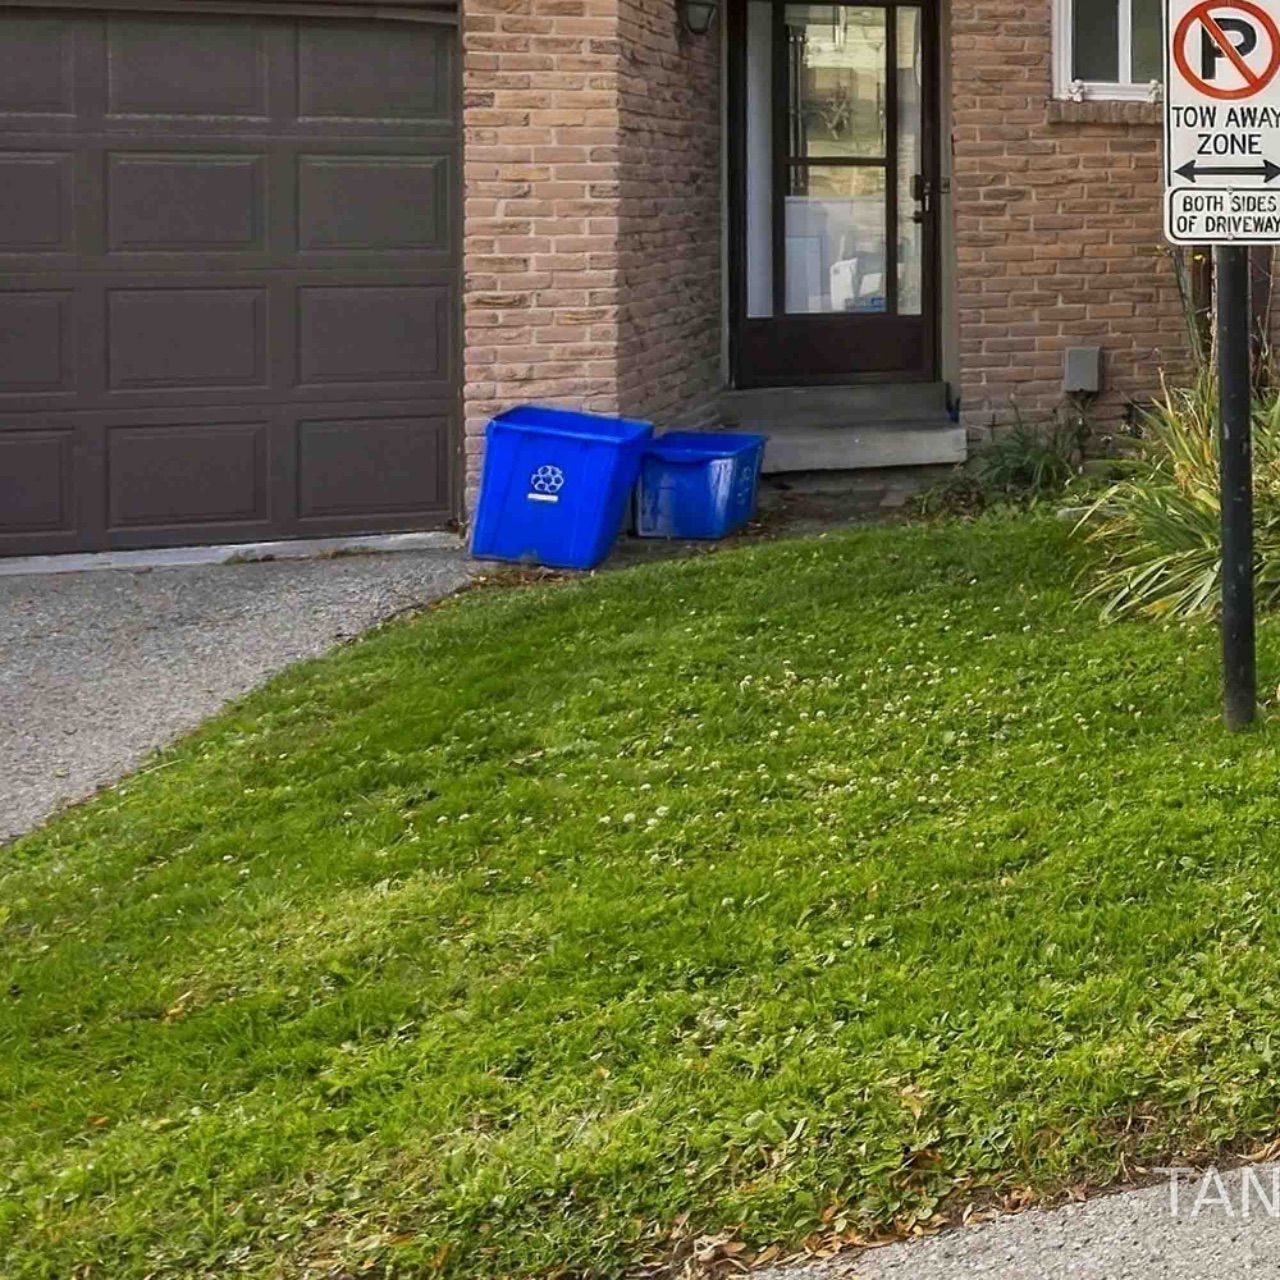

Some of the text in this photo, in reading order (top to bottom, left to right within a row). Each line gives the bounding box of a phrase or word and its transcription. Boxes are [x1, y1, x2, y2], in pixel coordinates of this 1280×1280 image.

[1172, 106, 1217, 128] TOW
[1197, 133, 1262, 155] ZONE
[1183, 195, 1277, 212] BOTH SIDES
[1177, 215, 1198, 233] OF
